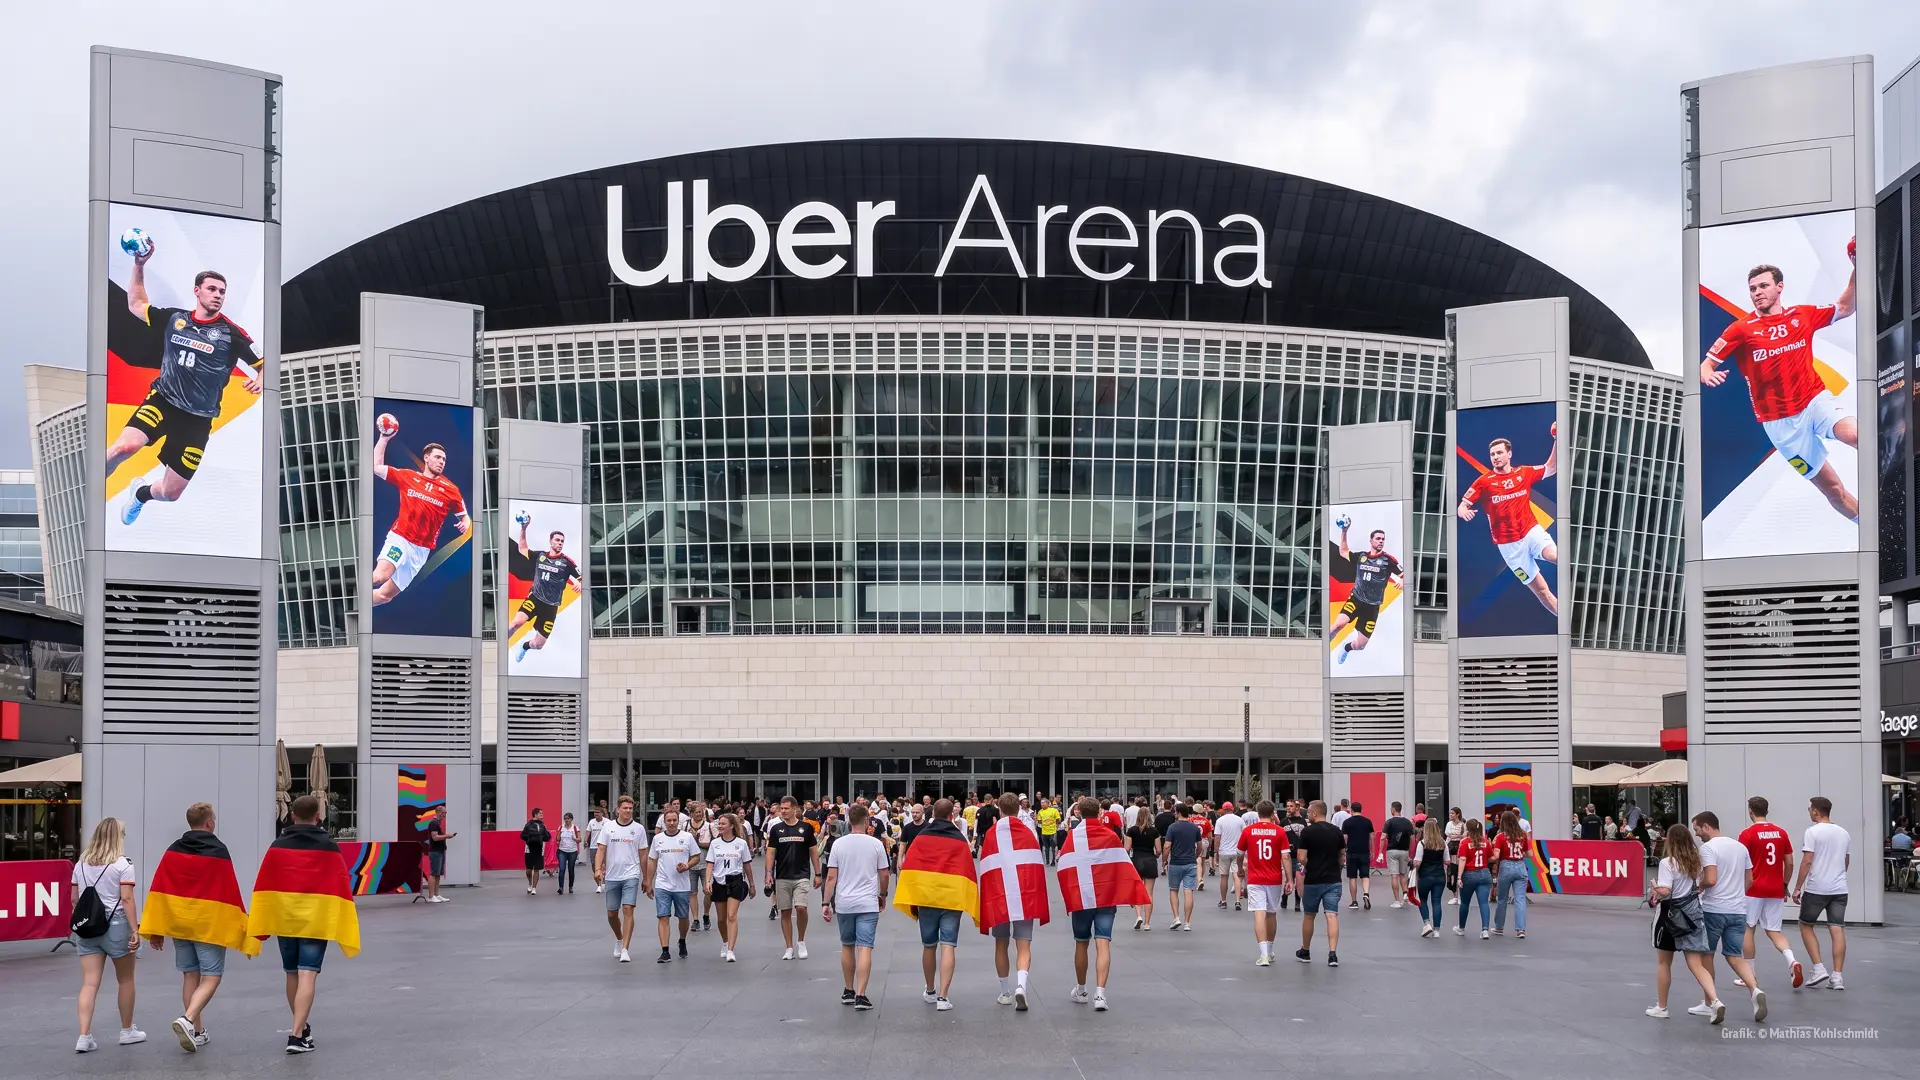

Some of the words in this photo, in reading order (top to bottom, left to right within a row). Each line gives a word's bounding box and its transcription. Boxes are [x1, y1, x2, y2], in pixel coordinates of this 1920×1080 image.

[607, 179, 895, 286] Uber
[934, 174, 1272, 288] Arena
[1256, 839, 1273, 860] 15
[1765, 842, 1776, 866] 3
[1549, 857, 1628, 878] BERLIN
